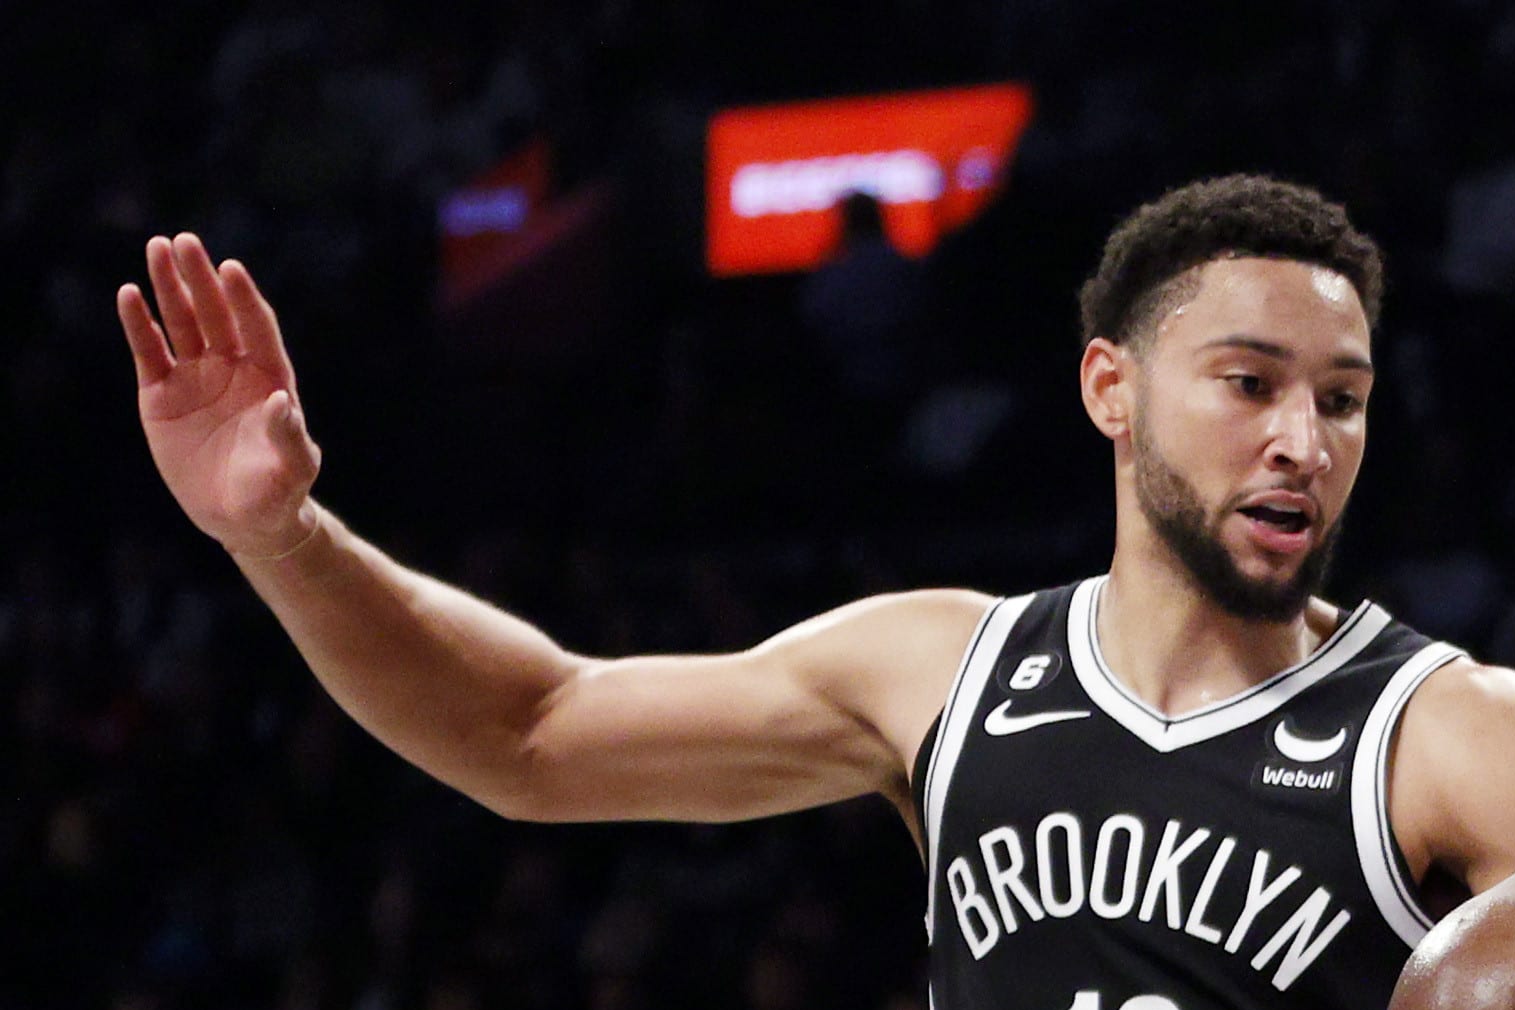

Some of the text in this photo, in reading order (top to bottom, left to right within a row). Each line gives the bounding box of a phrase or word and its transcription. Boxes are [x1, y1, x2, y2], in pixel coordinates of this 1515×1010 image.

[1009, 654, 1051, 690] 6
[1262, 765, 1335, 791] Webull
[946, 812, 1351, 992] BROOKLYN
